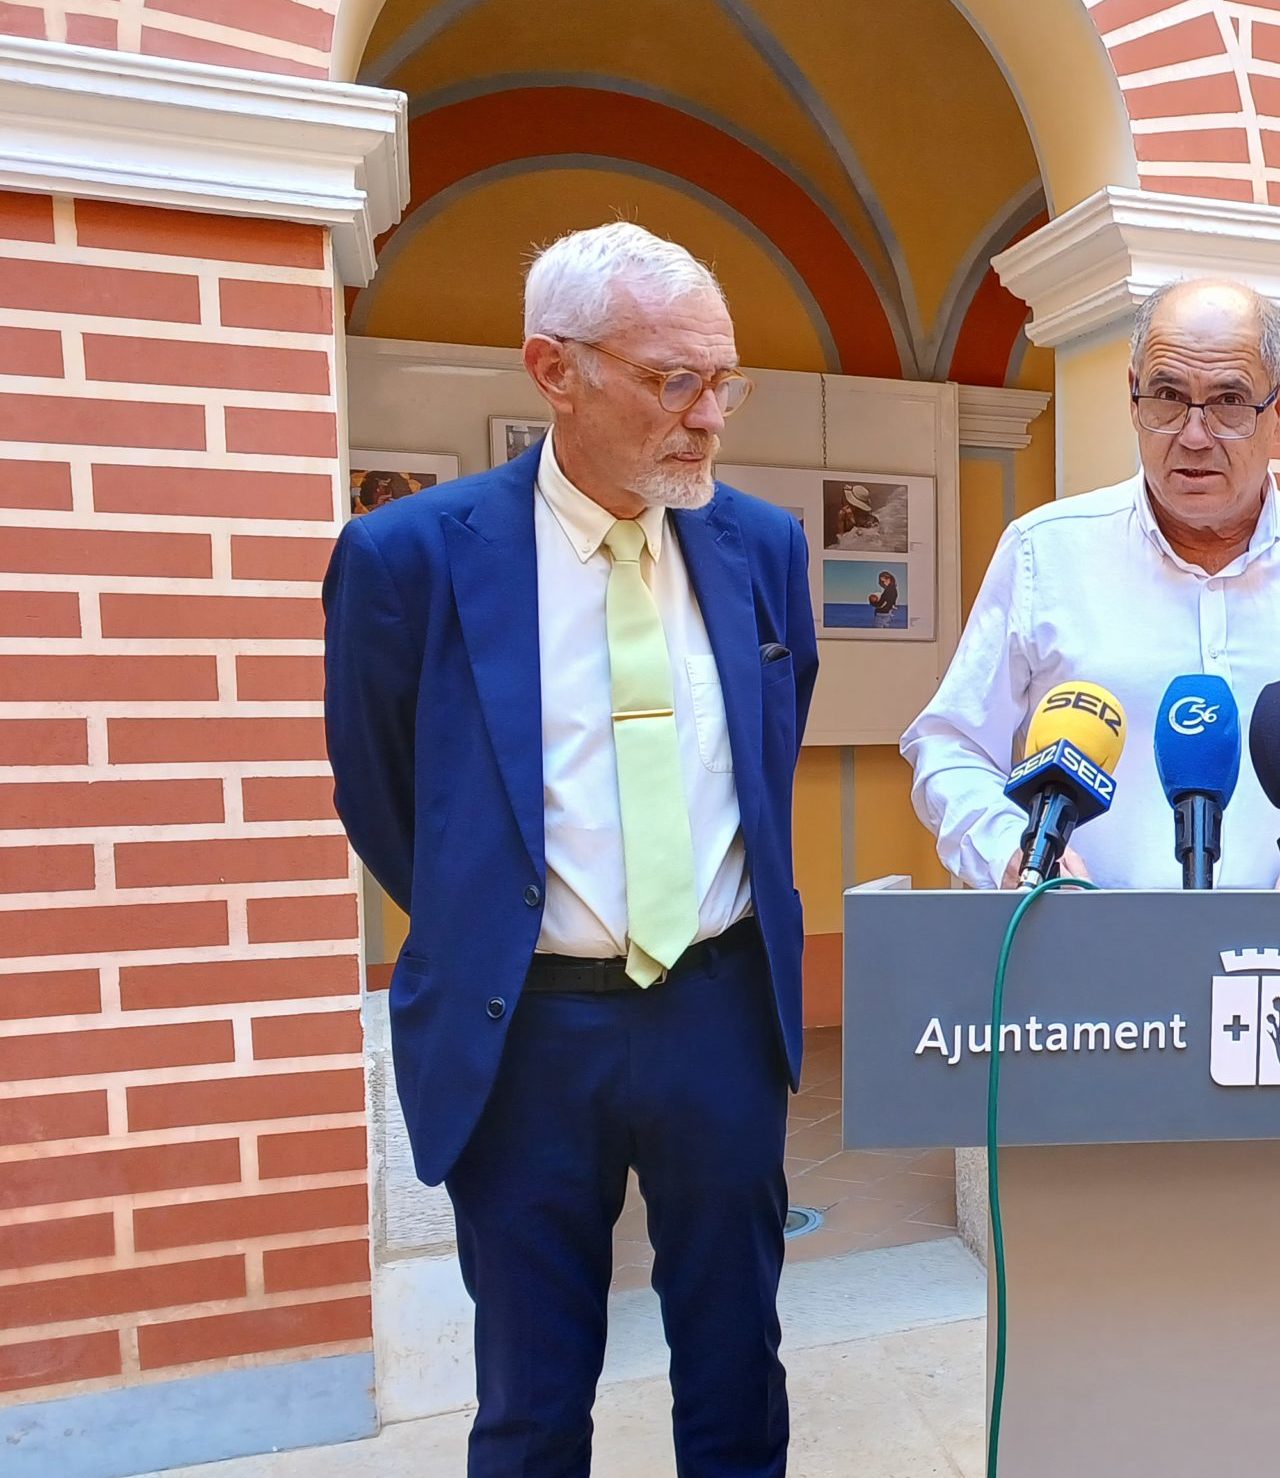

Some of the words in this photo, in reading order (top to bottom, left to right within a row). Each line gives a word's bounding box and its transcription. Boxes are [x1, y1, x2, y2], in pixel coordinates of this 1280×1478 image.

[1042, 691, 1122, 737] SER
[1007, 745, 1058, 785] SER
[1060, 746, 1113, 801] SER
[914, 1013, 1187, 1065] Ajuntament
